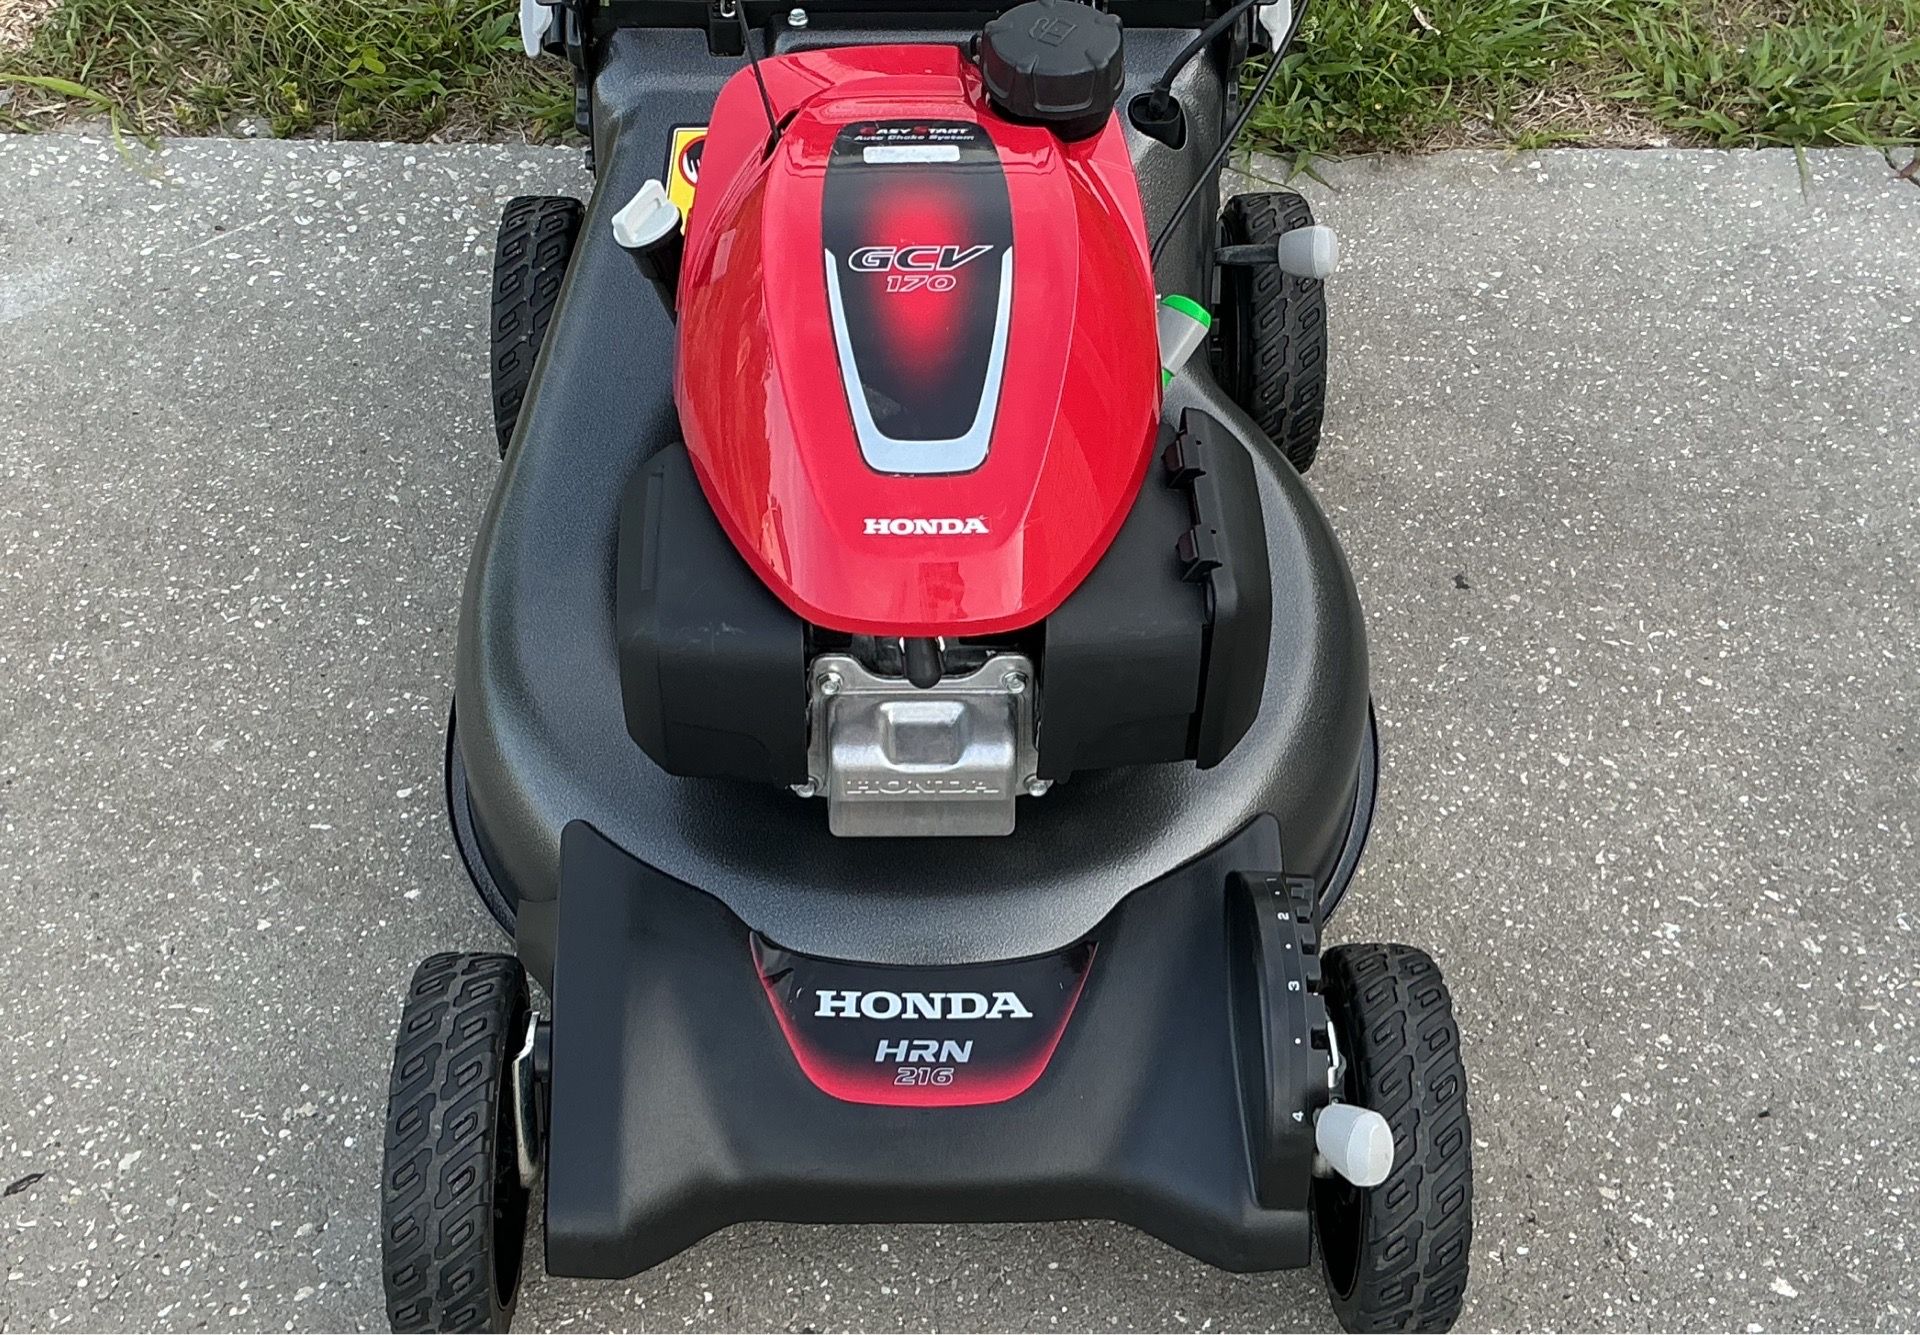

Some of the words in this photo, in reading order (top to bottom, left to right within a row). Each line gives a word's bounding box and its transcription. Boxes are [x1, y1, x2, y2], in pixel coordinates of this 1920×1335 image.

[848, 245, 994, 272] GCV
[886, 274, 957, 293] 170
[863, 517, 990, 535] HONDA
[845, 780, 1000, 795] HONDA
[1277, 911, 1290, 921] 2
[1287, 980, 1300, 992] 3
[814, 990, 1034, 1020] HONDA
[875, 1039, 974, 1063] HRN
[893, 1066, 955, 1086] 216
[1291, 1110, 1305, 1123] 4
